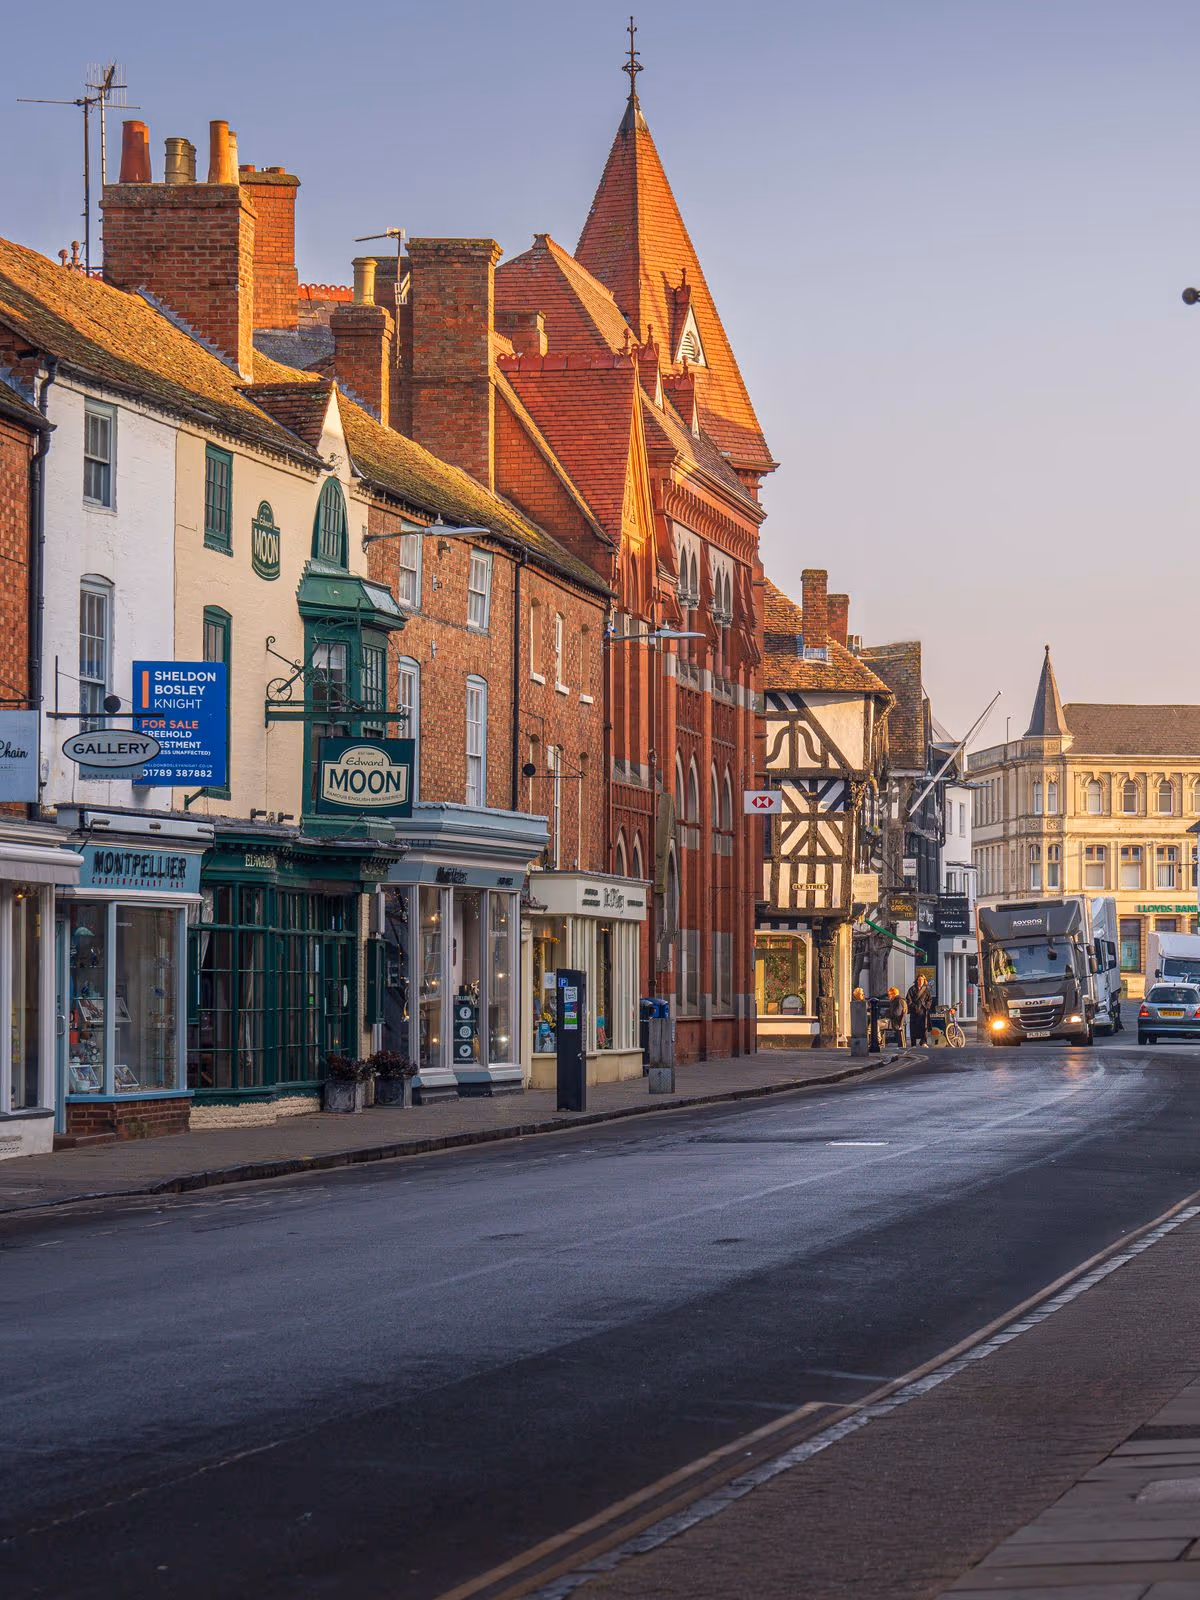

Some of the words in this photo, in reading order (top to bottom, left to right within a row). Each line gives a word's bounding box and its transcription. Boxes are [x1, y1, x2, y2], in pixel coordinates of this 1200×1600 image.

[255, 528, 279, 564] MOON
[154, 671, 216, 682] SHELDON
[154, 685, 206, 695] BOSLEY
[154, 698, 203, 709] KNIGHT
[142, 720, 166, 729] FOR
[169, 720, 199, 729] SALE
[73, 743, 150, 754] GALLERY
[159, 741, 202, 749] ESTMENT
[345, 757, 384, 767] Edward
[142, 769, 172, 777] 01789
[175, 769, 212, 777] 387882
[329, 768, 402, 794] MOON
[93, 851, 187, 879] MONTPELLIER
